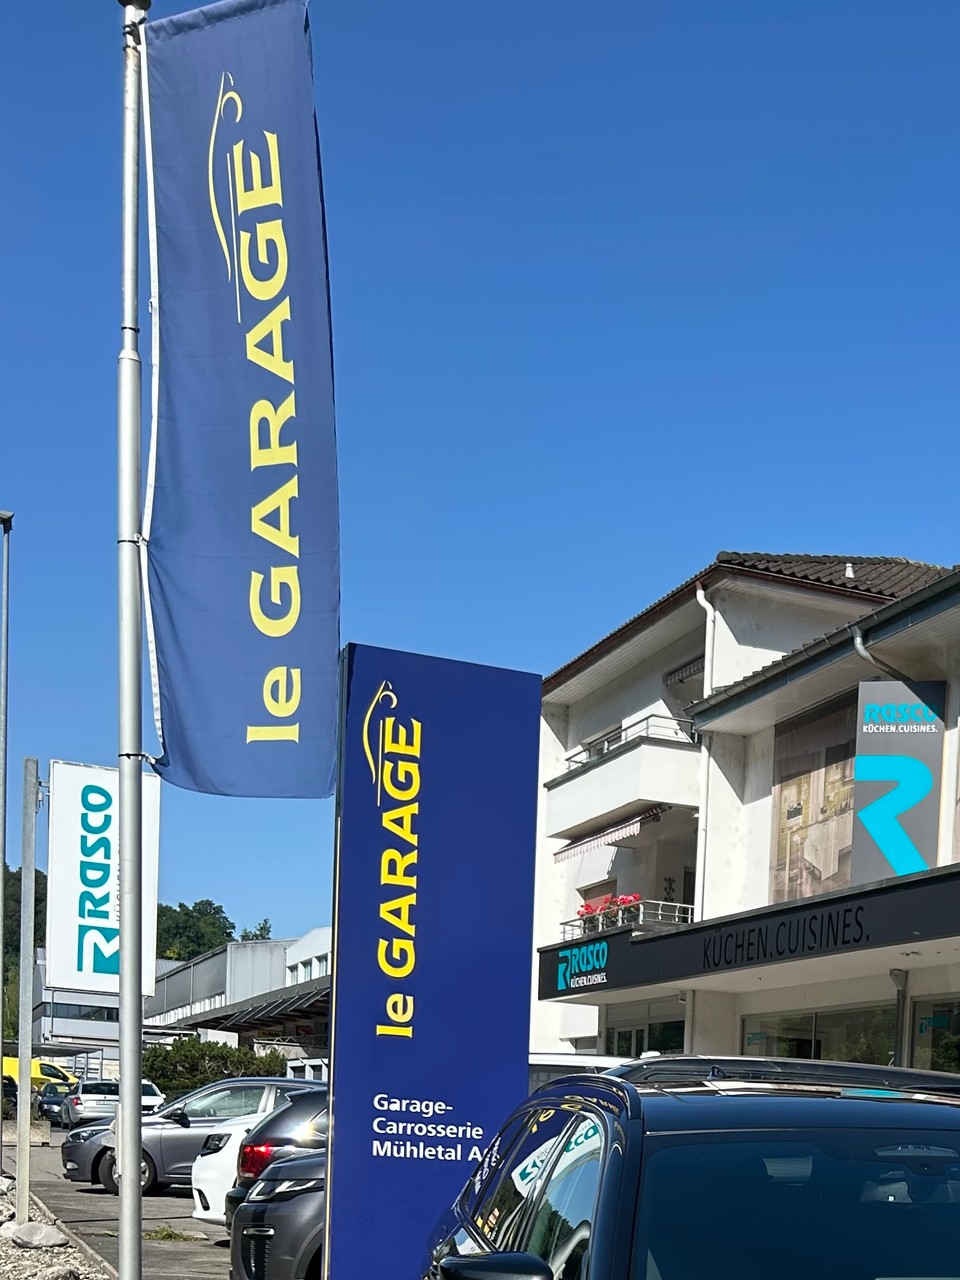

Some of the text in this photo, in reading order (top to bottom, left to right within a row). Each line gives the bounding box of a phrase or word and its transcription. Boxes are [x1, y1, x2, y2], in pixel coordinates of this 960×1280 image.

[233, 132, 301, 742] le GARAGE
[376, 717, 421, 1037] le GARAGE
[373, 1093, 454, 1118] Garage-
[372, 1117, 484, 1139] Carrosserie
[372, 1140, 489, 1162] Mühletal A
